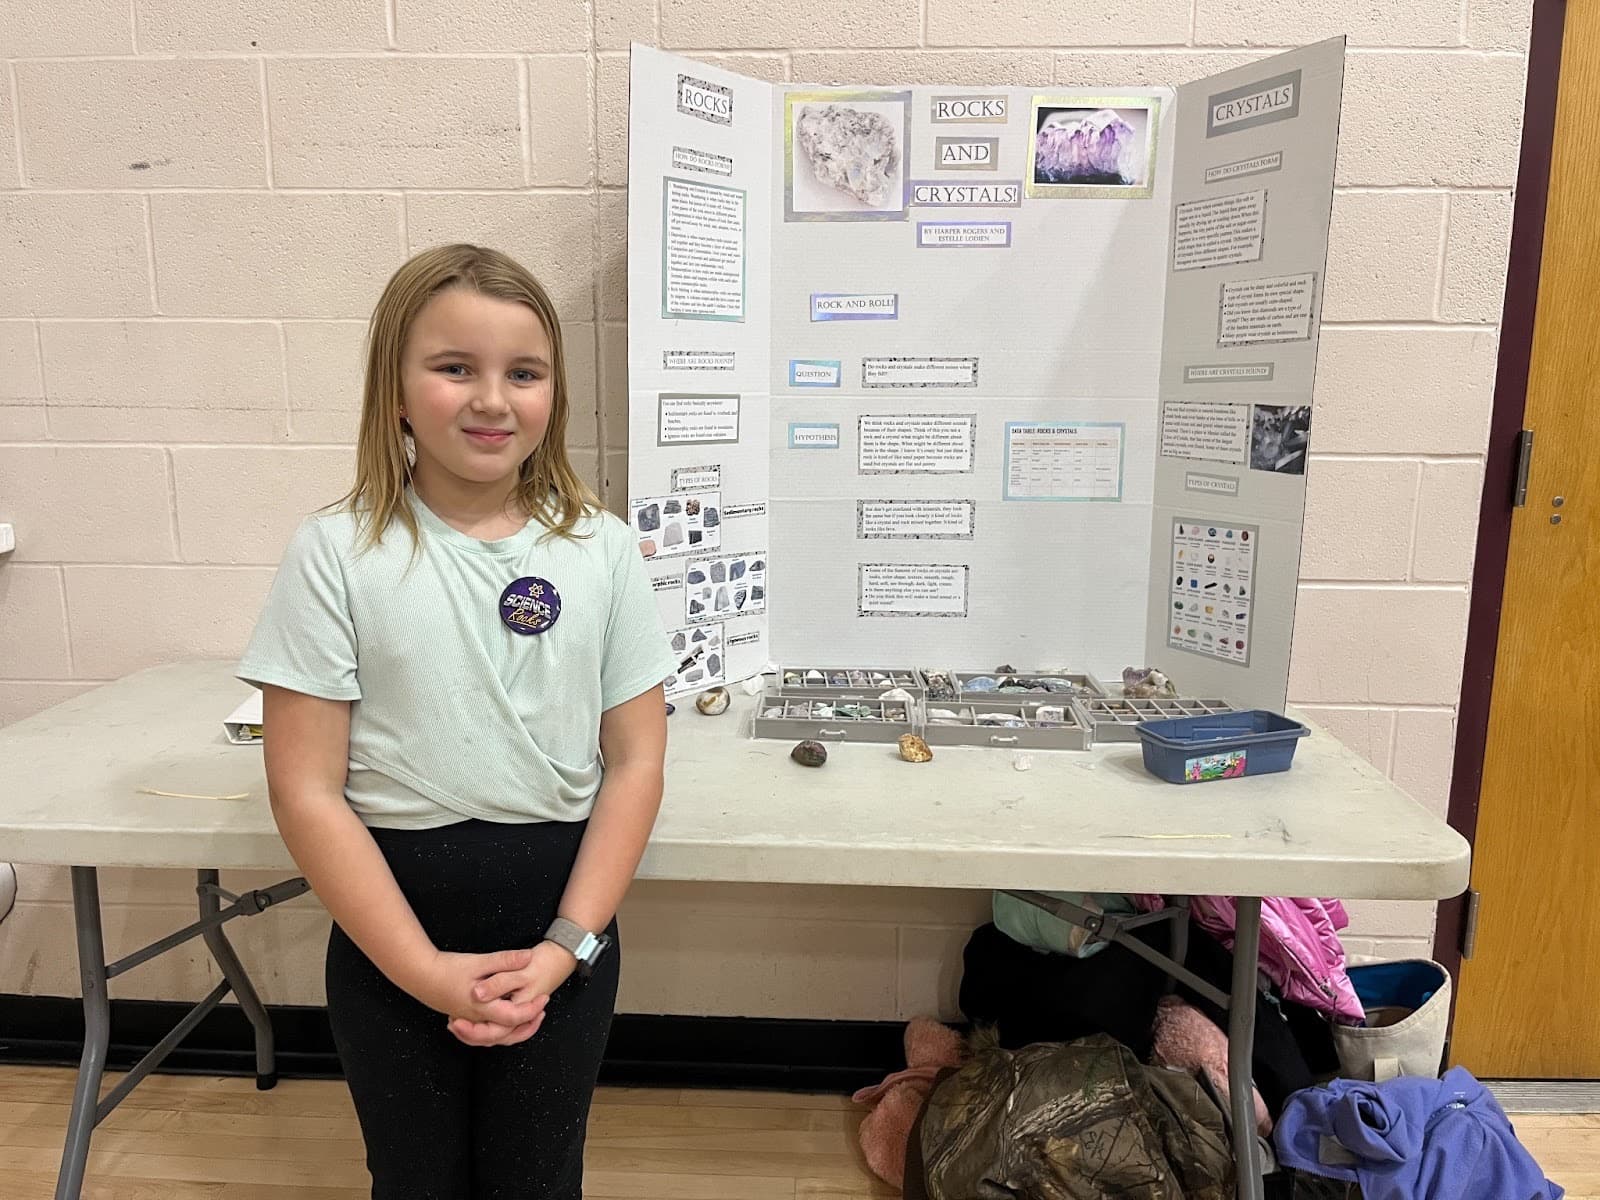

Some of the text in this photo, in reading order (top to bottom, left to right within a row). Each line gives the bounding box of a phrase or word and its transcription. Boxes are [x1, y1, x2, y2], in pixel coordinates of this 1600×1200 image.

[685, 88, 728, 114] ROCKS
[938, 100, 1004, 118] ROCKS
[1216, 88, 1290, 122] CRYSTALS
[943, 145, 989, 161] AND
[1233, 160, 1260, 172] CRYSTALS
[916, 186, 1017, 202] CRYSTALS!
[817, 299, 894, 310] ROCK AND ROLL!
[504, 594, 552, 620] SCIENCE
[508, 608, 542, 625] Rocks
